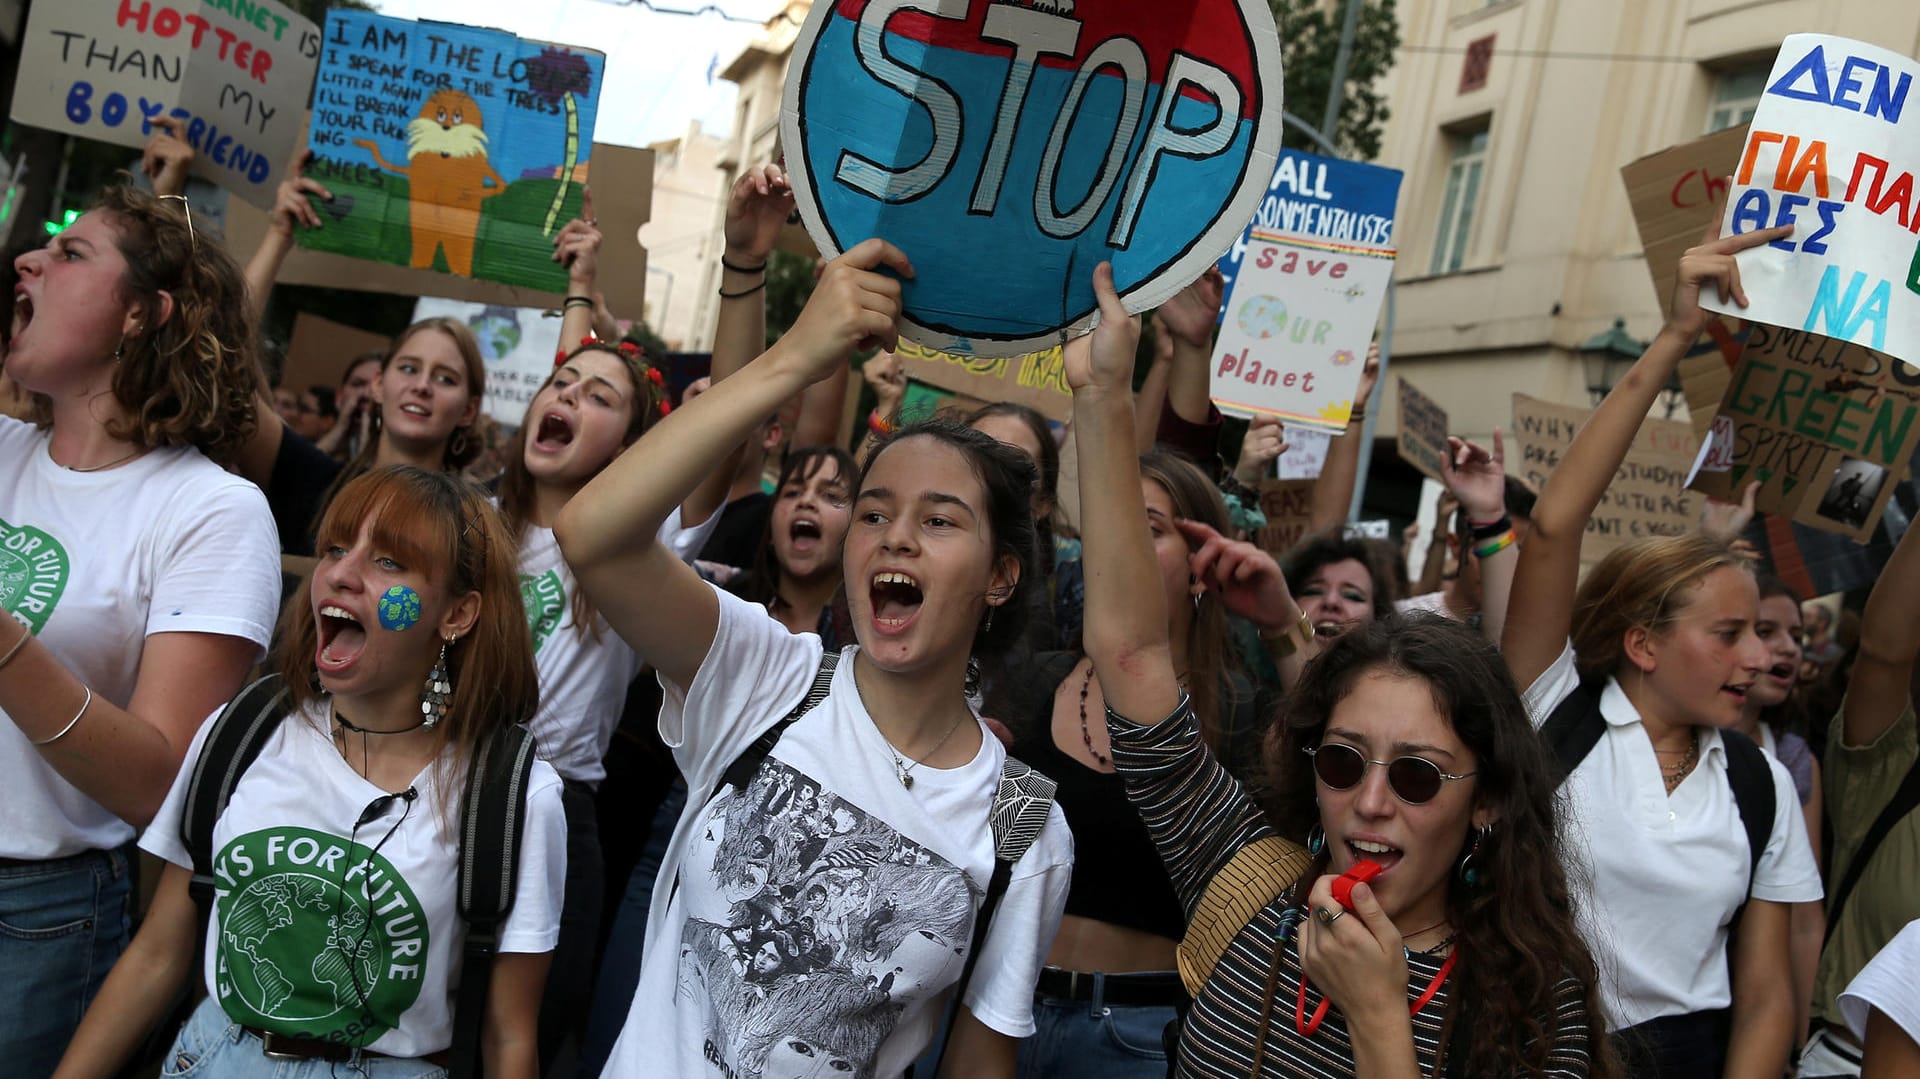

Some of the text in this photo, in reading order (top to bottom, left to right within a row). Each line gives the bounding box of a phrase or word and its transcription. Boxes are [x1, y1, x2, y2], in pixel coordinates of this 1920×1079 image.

[117, 0, 273, 84] HOTTER
[203, 0, 320, 59] ANET IS
[329, 18, 351, 46] I
[361, 24, 407, 60] AM
[426, 35, 485, 73] THE
[50, 30, 276, 134] THAN MY
[326, 48, 338, 65] I
[347, 53, 407, 79] SPEAK
[412, 68, 453, 91] FOR
[462, 76, 495, 98] THE
[1767, 45, 1913, 124] ΔΕΝ
[318, 108, 368, 130] YOUR
[355, 94, 411, 118] BREAK
[834, 0, 1240, 250] STOP
[314, 129, 345, 146] ING
[1269, 156, 1332, 200] ALL
[1737, 131, 1920, 235] ΓΙΑ ΠΑ
[1217, 348, 1314, 393] planet
[1521, 416, 1576, 442] WHY
[1728, 360, 1918, 465] GREEN
[1732, 423, 1842, 485] SPIRIT
[267, 835, 346, 873] FOR
[344, 858, 422, 981] FUTURE
